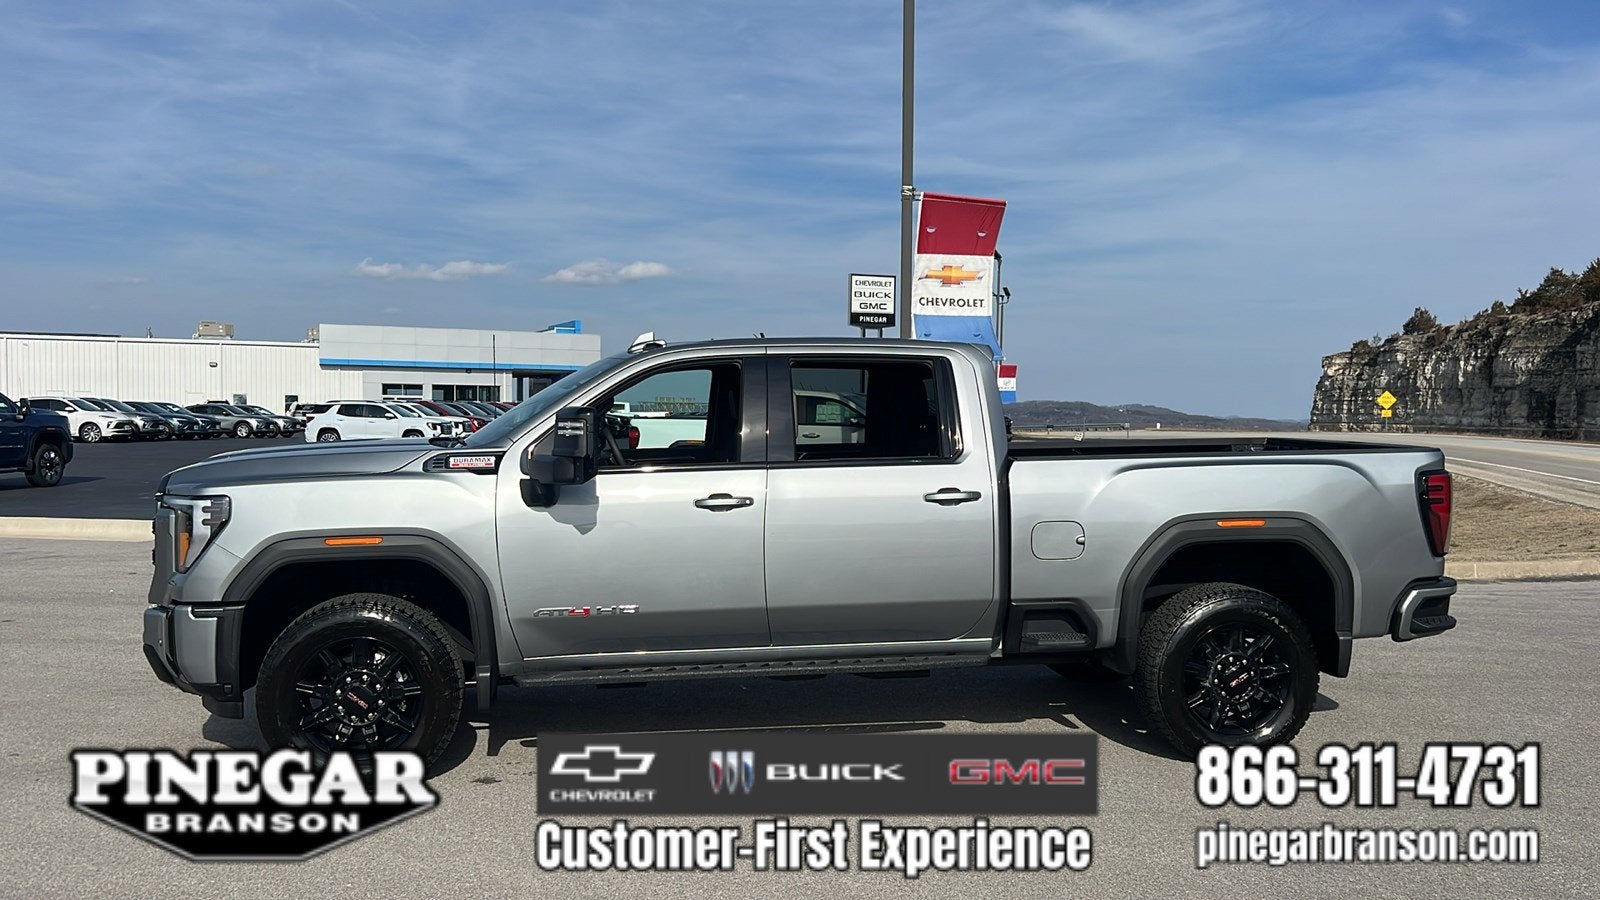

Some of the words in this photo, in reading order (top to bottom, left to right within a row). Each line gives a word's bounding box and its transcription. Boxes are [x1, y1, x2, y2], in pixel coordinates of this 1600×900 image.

[854, 291, 892, 299] BUICK
[860, 302, 887, 310] GMC
[919, 297, 985, 308] CHEVROLET
